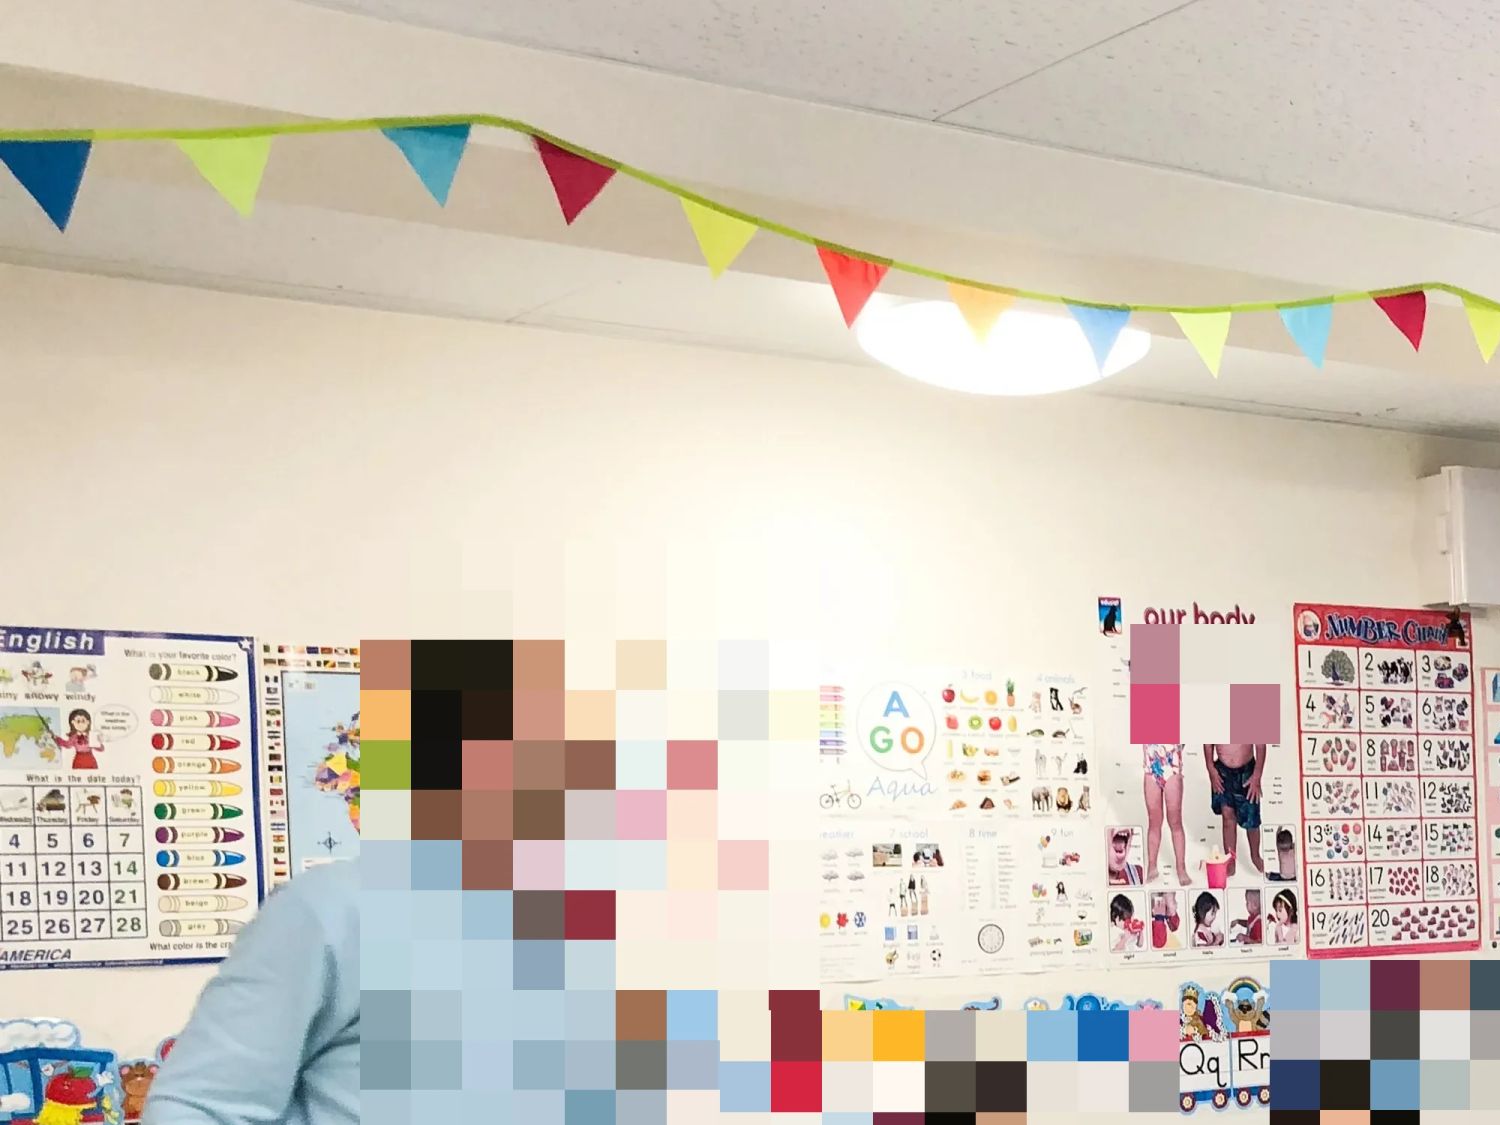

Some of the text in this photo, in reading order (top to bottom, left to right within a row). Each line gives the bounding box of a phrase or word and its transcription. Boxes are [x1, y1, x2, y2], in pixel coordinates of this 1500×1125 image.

[179, 651, 210, 661] favorite
[1364, 652, 1374, 671] 2
[1422, 655, 1431, 673] 3
[883, 690, 910, 718] A
[1305, 694, 1316, 712] 4
[1365, 695, 1375, 714] 5
[1422, 697, 1432, 716] 6
[869, 725, 925, 754] GO
[1307, 737, 1317, 756] 7
[1366, 739, 1376, 757] 8
[1423, 739, 1432, 757] 9
[26, 775, 49, 783] What
[68, 775, 81, 783] the
[87, 775, 106, 783] date
[112, 775, 141, 784] today?
[866, 776, 938, 802] Aqua
[1306, 781, 1322, 800] 10
[1365, 781, 1378, 800] 11
[1422, 781, 1437, 799] 12
[9, 834, 20, 848] 4
[47, 833, 58, 848] 5
[83, 833, 94, 848] 6
[119, 833, 130, 847] 7
[1308, 825, 1323, 843] 13
[1367, 824, 1382, 842] 14
[1424, 823, 1438, 841] 15
[5, 862, 27, 877] 11
[42, 861, 66, 877] 12
[78, 861, 102, 876] 13
[114, 860, 138, 875] 14
[1369, 867, 1384, 885] 17
[1426, 865, 1439, 883] 18
[1310, 868, 1325, 887] 16
[6, 891, 31, 906] 18
[44, 890, 68, 905] 19
[79, 890, 105, 905] 20
[115, 889, 138, 904] 21
[7, 919, 33, 935] 25
[45, 918, 70, 934] 26
[80, 918, 106, 933] 27
[117, 917, 141, 932] 28
[1311, 912, 1326, 930] 19
[1371, 909, 1390, 928] 20
[0, 948, 71, 961] AMERICA
[1180, 1039, 1270, 1088] Qq Rr
